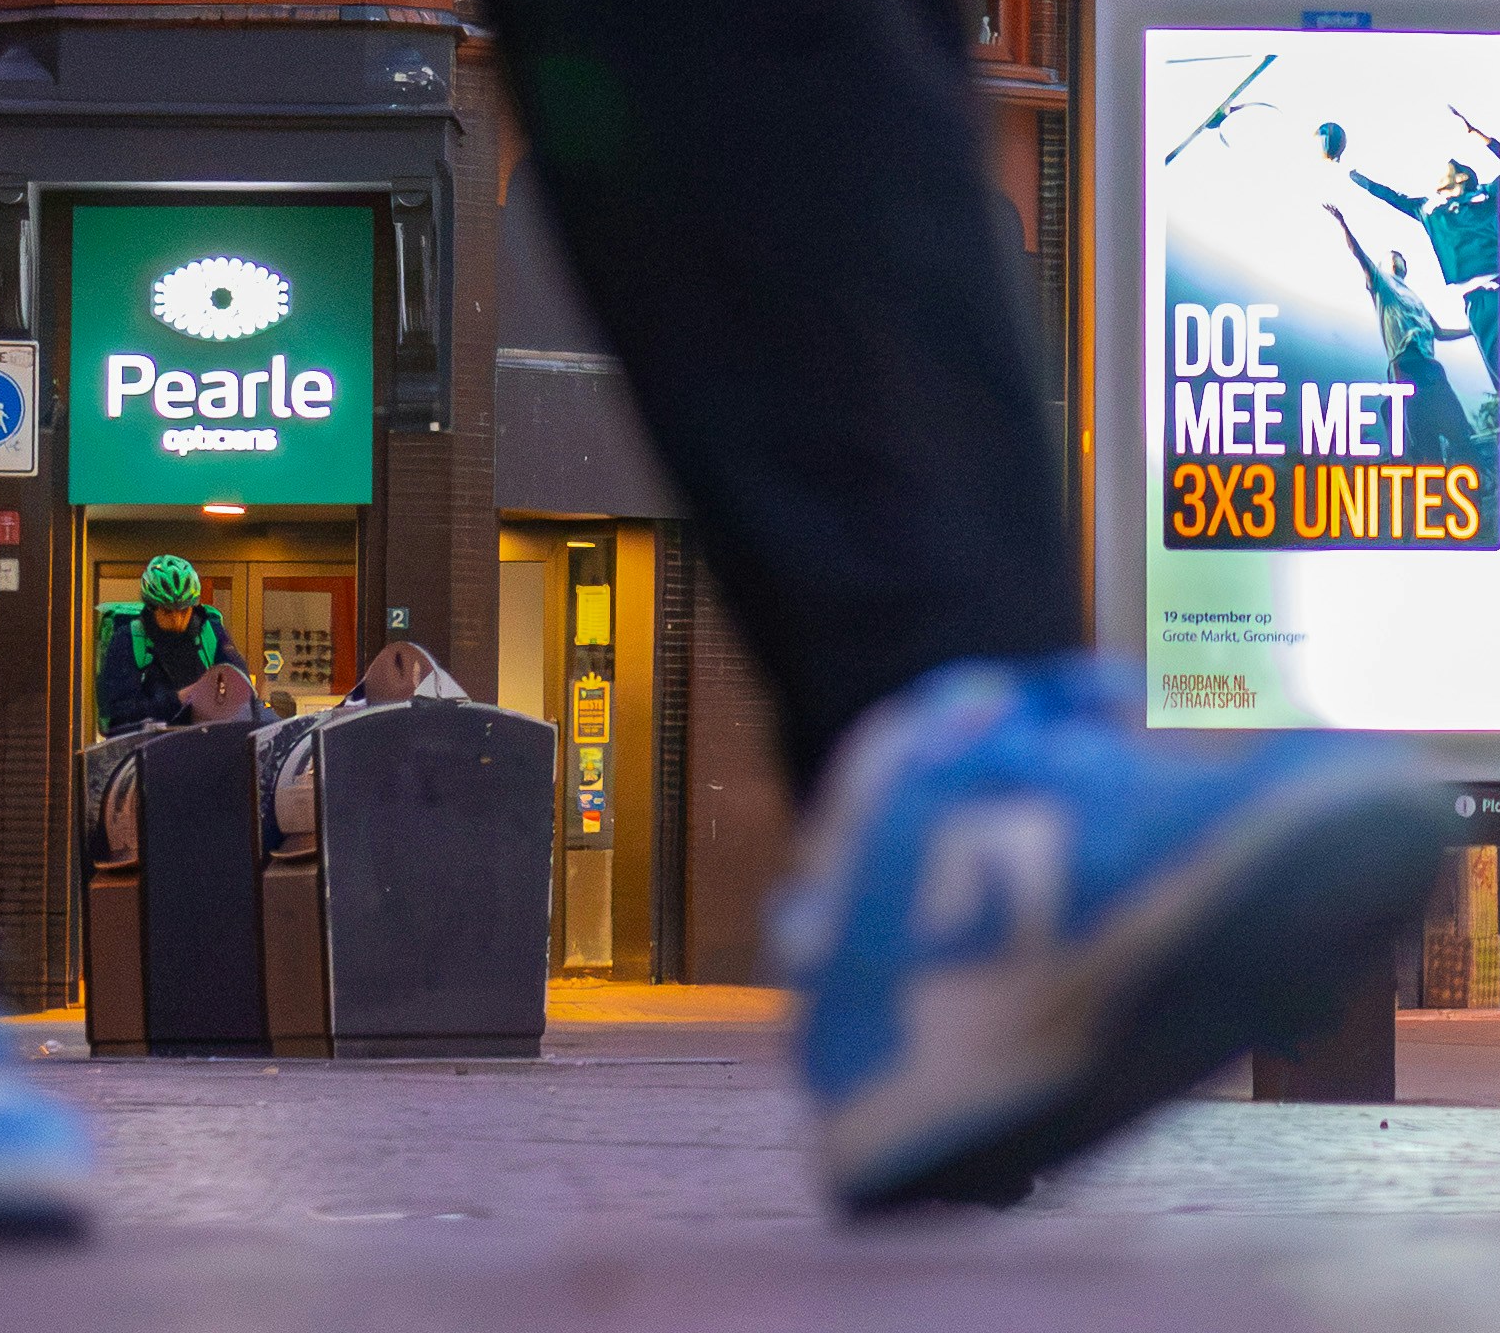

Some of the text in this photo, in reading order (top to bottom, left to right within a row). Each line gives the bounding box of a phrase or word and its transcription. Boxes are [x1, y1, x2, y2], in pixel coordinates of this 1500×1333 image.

[1174, 303, 1280, 379] DOE
[107, 354, 334, 420] Pearle
[1174, 381, 1416, 457] MEE MET
[1172, 463, 1481, 540] 3X3 UNITES
[392, 610, 405, 628] 2
[1164, 611, 1272, 625] 19 september op
[1162, 630, 1197, 642] Grote
[1200, 630, 1241, 643] Markt,
[1162, 674, 1248, 691] RABOBANK.NL
[1163, 692, 1257, 709] /STRAATSPORT
